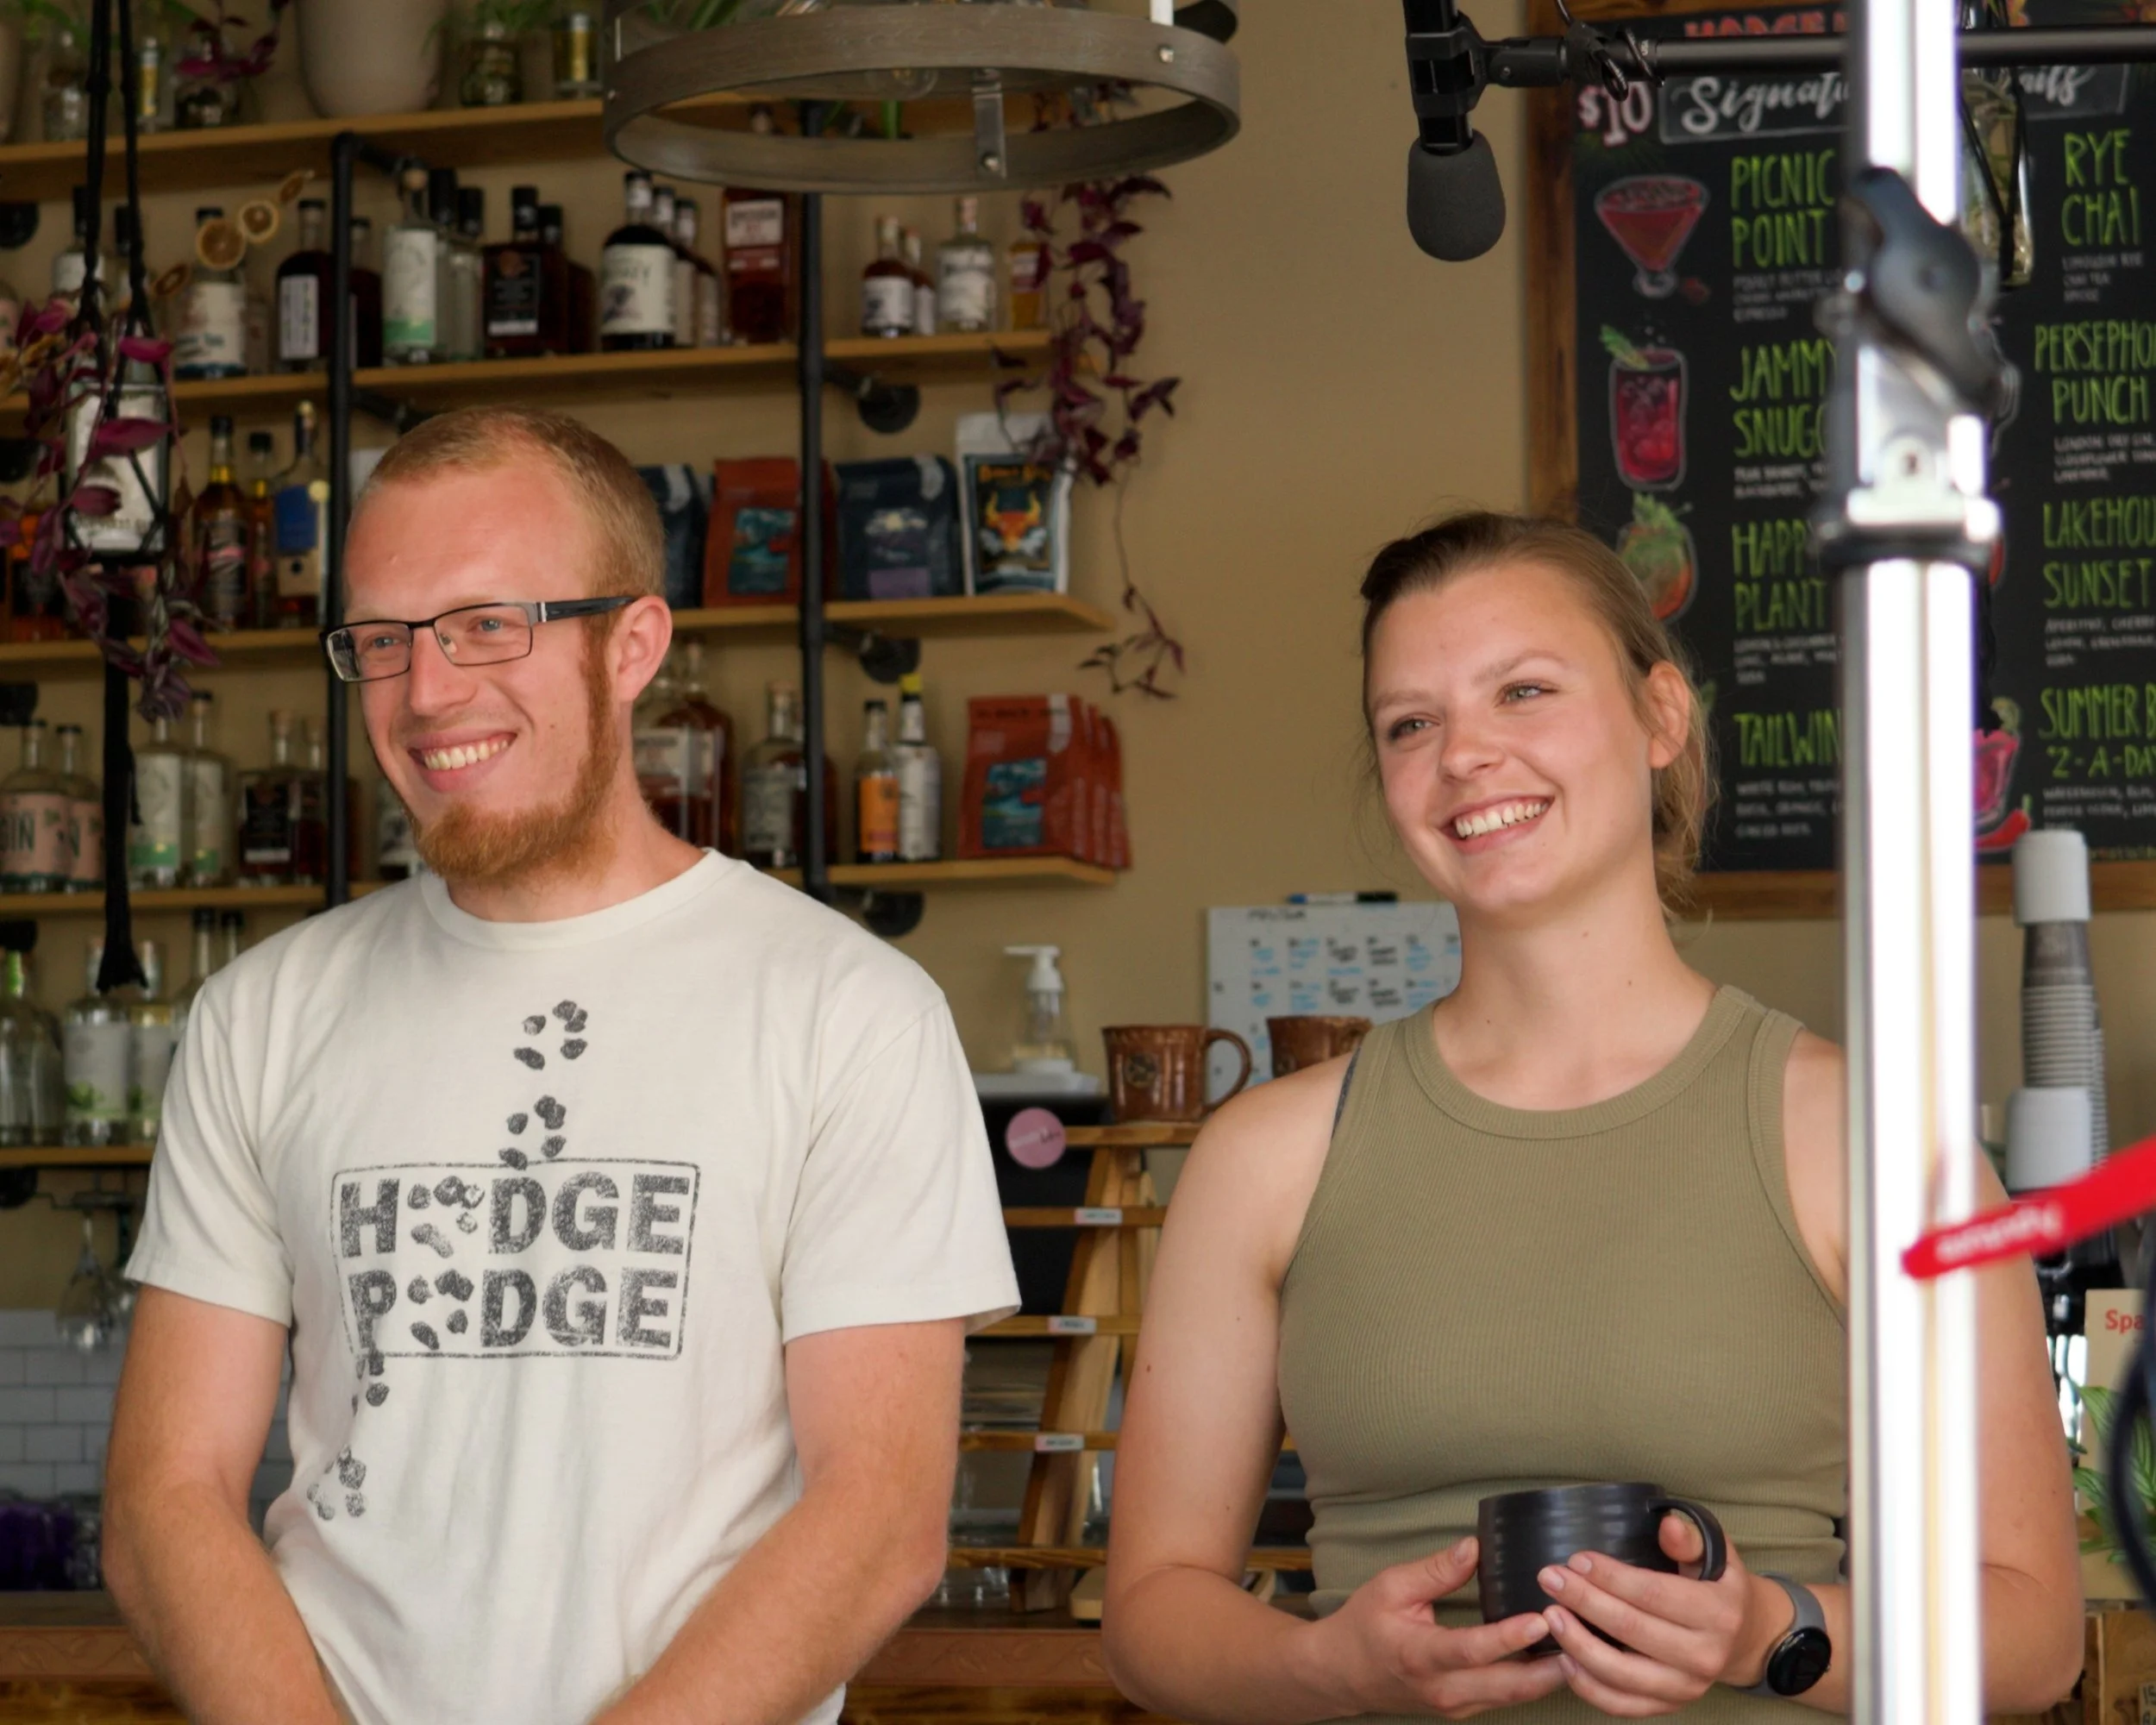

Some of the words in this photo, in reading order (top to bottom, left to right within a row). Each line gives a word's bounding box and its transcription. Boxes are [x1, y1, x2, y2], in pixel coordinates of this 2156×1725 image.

[1731, 148, 1835, 210] PICNIC
[2064, 129, 2130, 187] RYE
[1731, 209, 1827, 269] POINT
[2061, 185, 2140, 247] CHAI
[2052, 374, 2150, 424] PUNCH
[1733, 577, 1827, 632] PLANT
[2042, 558, 2153, 609] SUNSET
[2039, 684, 2140, 740] SUMMER
[2046, 744, 2156, 778] 2-A-DA
[341, 1171, 691, 1258] HDGE
[348, 1264, 679, 1351] PDGE
